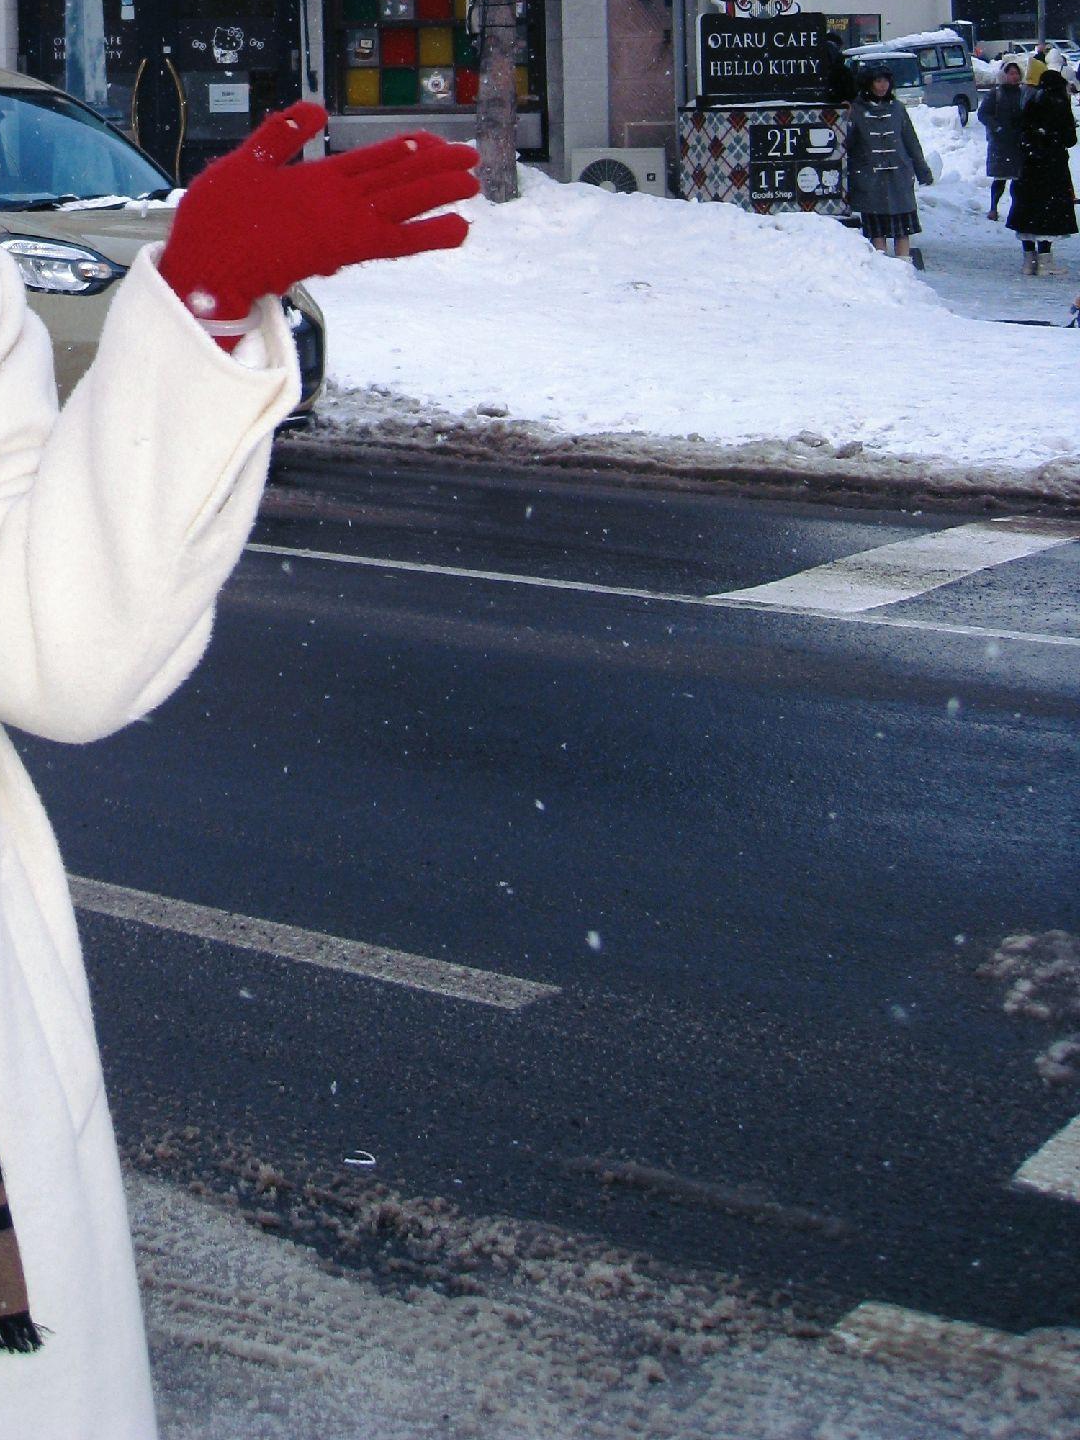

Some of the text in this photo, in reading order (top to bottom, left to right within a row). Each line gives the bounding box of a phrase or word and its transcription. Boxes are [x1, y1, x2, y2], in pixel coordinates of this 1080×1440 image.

[708, 31, 818, 48] OTARU CAFE
[710, 59, 820, 76] HELLO KITTY
[767, 128, 801, 157] 2F
[751, 191, 793, 199] Goods Shop
